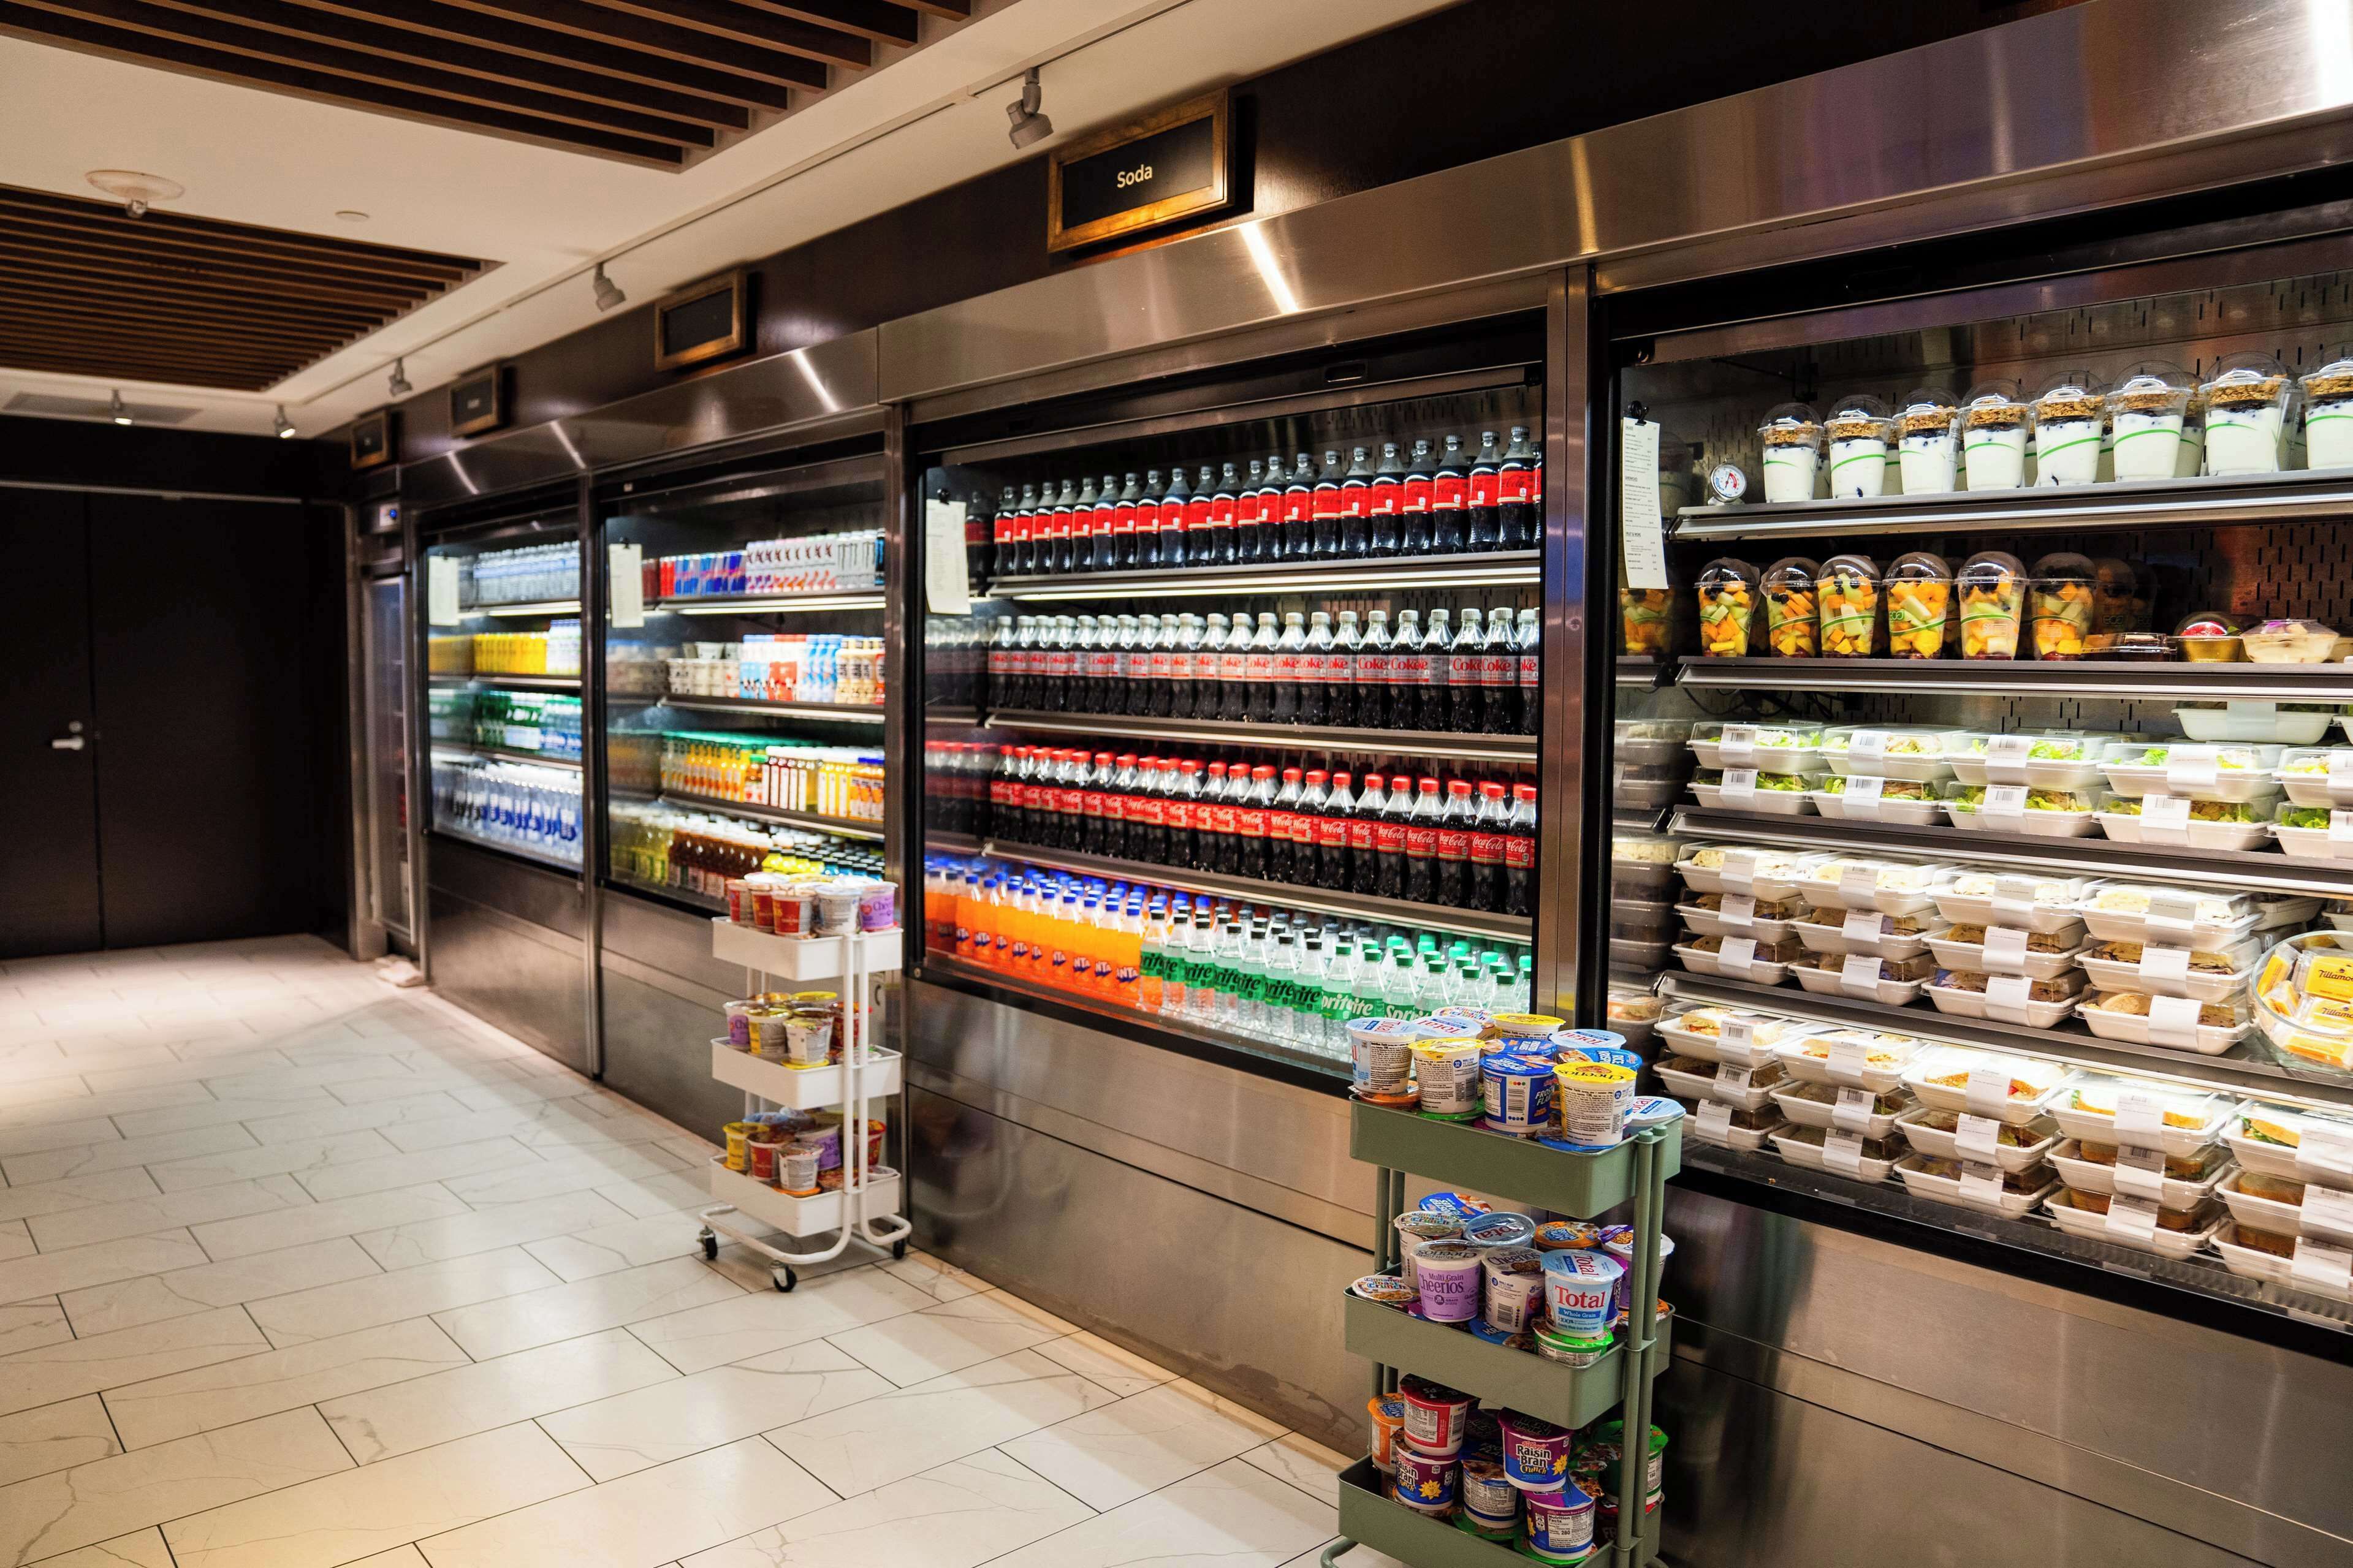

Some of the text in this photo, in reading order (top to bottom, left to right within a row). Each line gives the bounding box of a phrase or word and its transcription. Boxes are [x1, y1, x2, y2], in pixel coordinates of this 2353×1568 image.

[1117, 164, 1153, 189] Soda
[1359, 657, 1388, 670] Coke
[1482, 658, 1512, 672] Coke
[1418, 1020, 1462, 1034] Total
[1488, 1252, 1540, 1265] Cheerios
[1574, 1254, 1600, 1277] Total
[1419, 1273, 1464, 1294] Cheerios
[1554, 1285, 1606, 1309] Total
[1564, 1309, 1581, 1318] Whole
[1516, 1444, 1551, 1460] Raisin
[1519, 1456, 1547, 1468] Bran
[1397, 1460, 1418, 1480] aisin
[1519, 1465, 1548, 1475] Crunch
